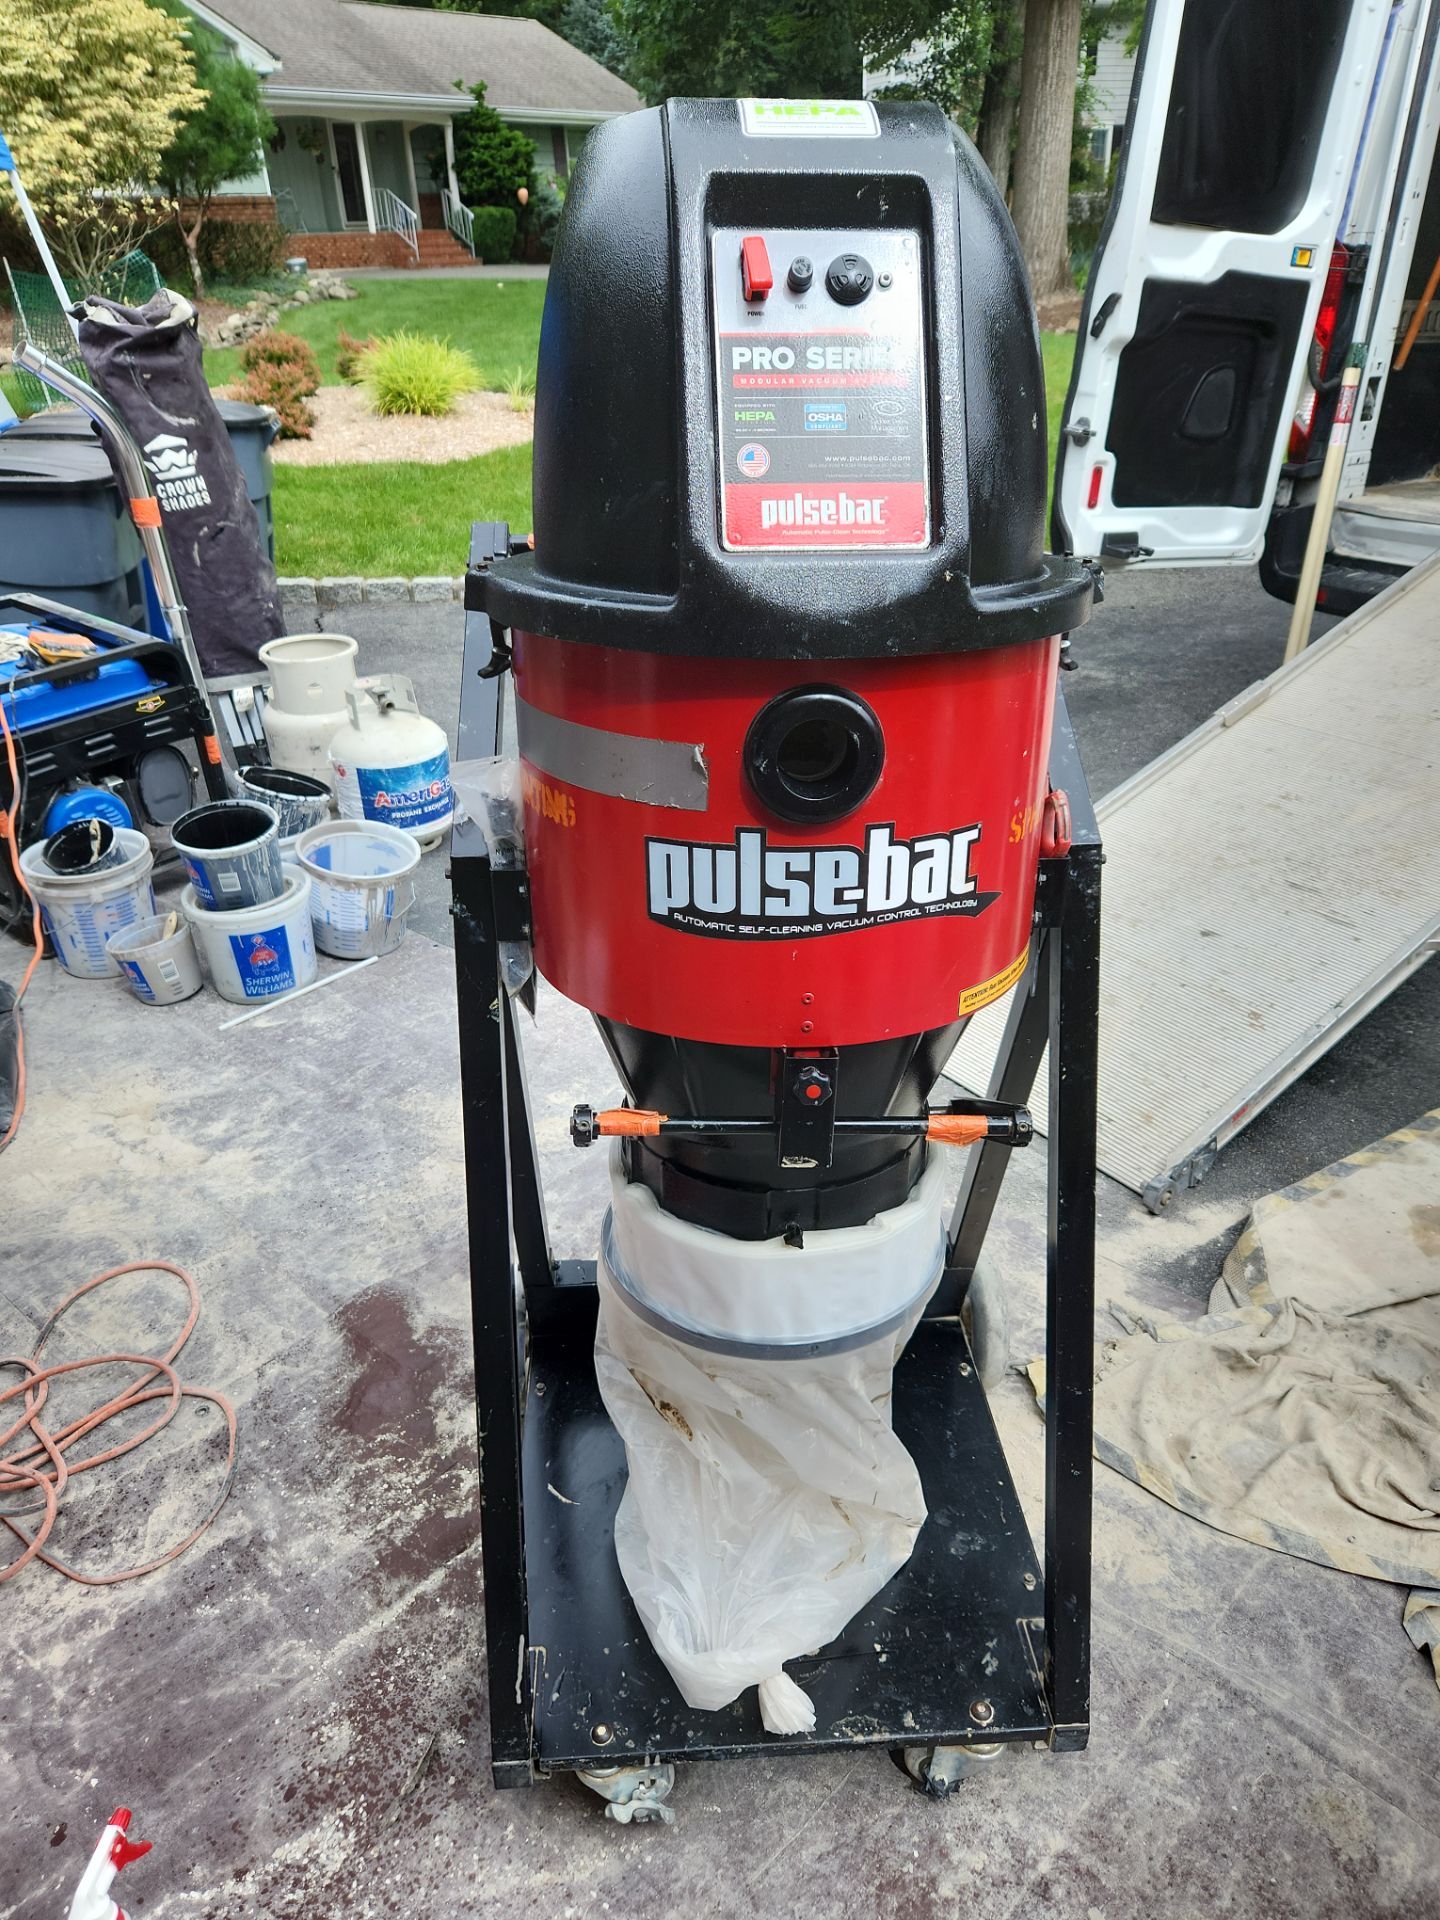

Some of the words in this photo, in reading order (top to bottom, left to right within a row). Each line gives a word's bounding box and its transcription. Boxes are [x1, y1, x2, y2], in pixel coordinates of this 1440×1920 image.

[754, 106, 862, 116] HEPA
[731, 346, 796, 370] PRO
[740, 378, 795, 386] MODULAR
[734, 411, 776, 421] HEPA
[808, 413, 844, 422] OSHA
[156, 475, 207, 499] CROWN
[162, 491, 212, 512] SHADES
[391, 807, 423, 819] PROPANE
[673, 912, 735, 933] AUTOMATIC
[738, 923, 823, 935] SELF-CLEANING
[826, 916, 875, 931] VACUUM
[877, 909, 922, 923] CONTROL
[924, 899, 978, 914] TECHNOLOGY
[246, 971, 290, 986] SHERWIN
[245, 978, 295, 995] WILLIAMS
